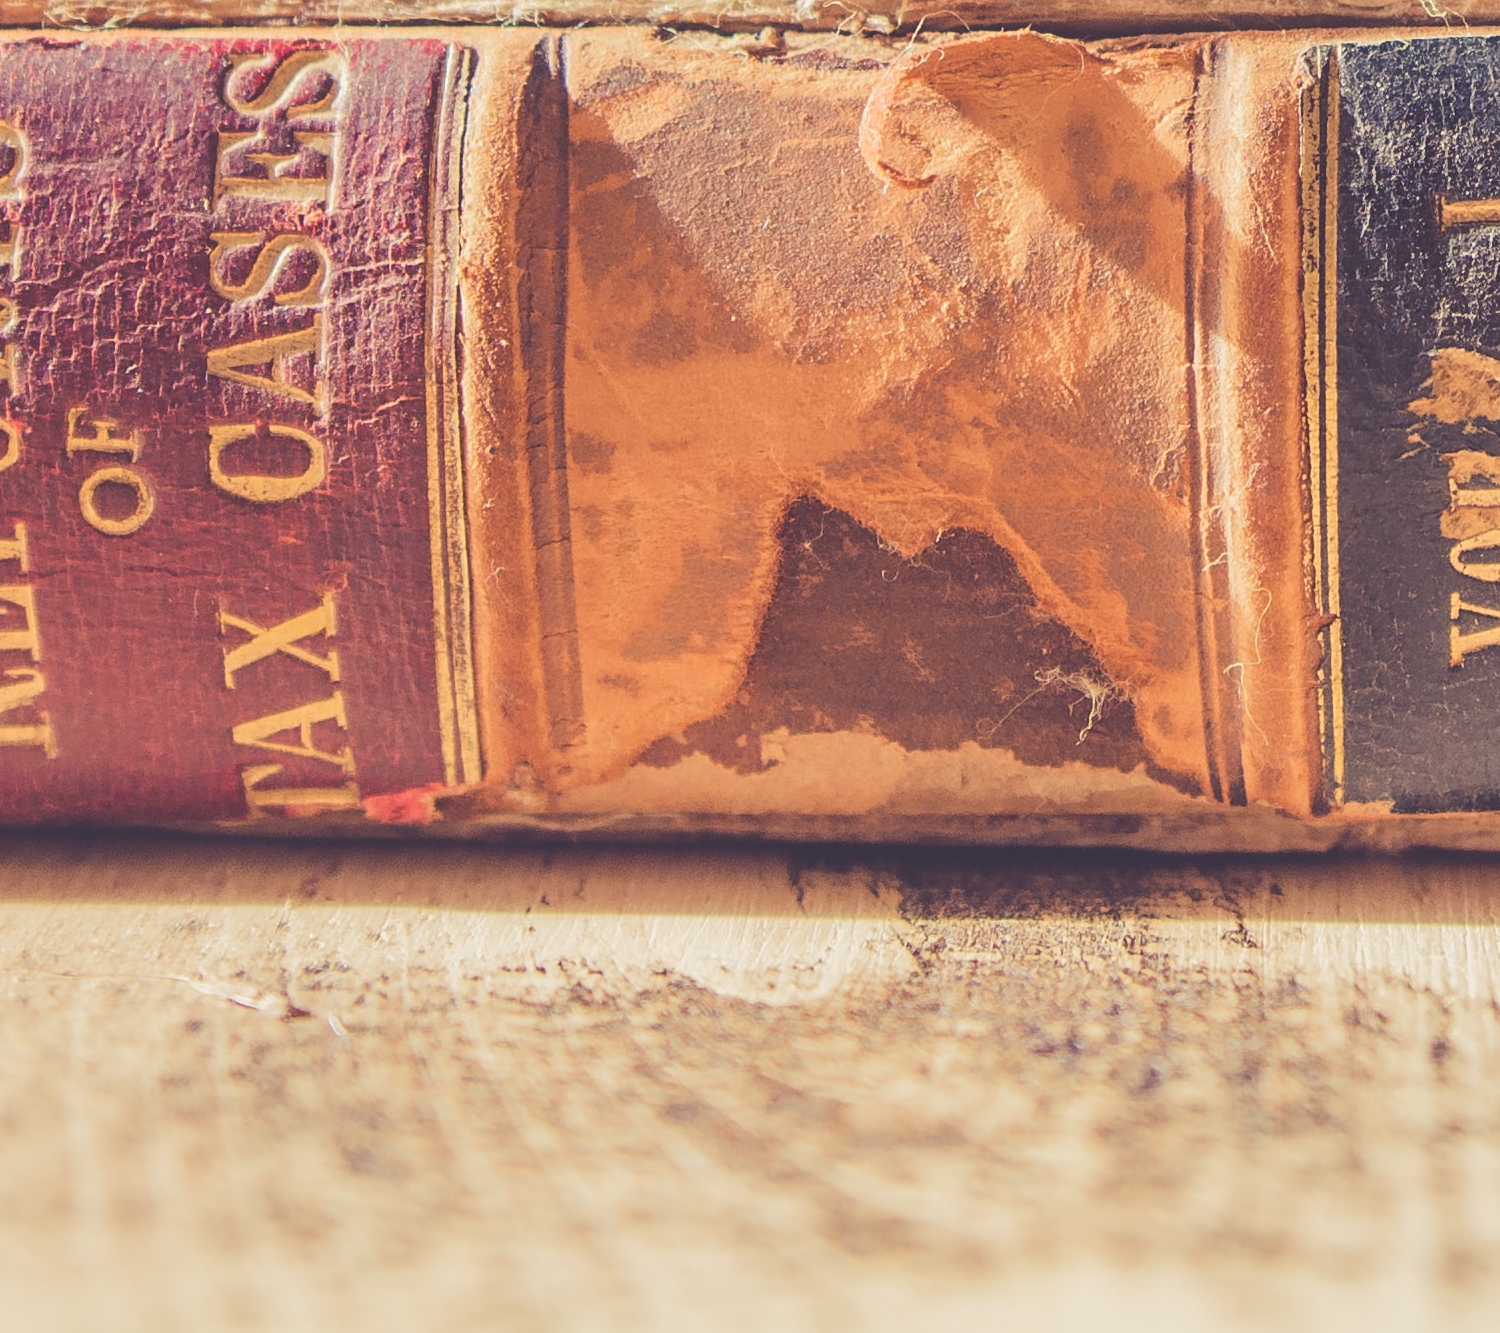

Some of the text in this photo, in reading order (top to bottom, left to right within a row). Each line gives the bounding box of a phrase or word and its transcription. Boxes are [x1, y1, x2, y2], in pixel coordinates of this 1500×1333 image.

[66, 405, 156, 536] OF
[208, 48, 362, 819] TAX CASES
